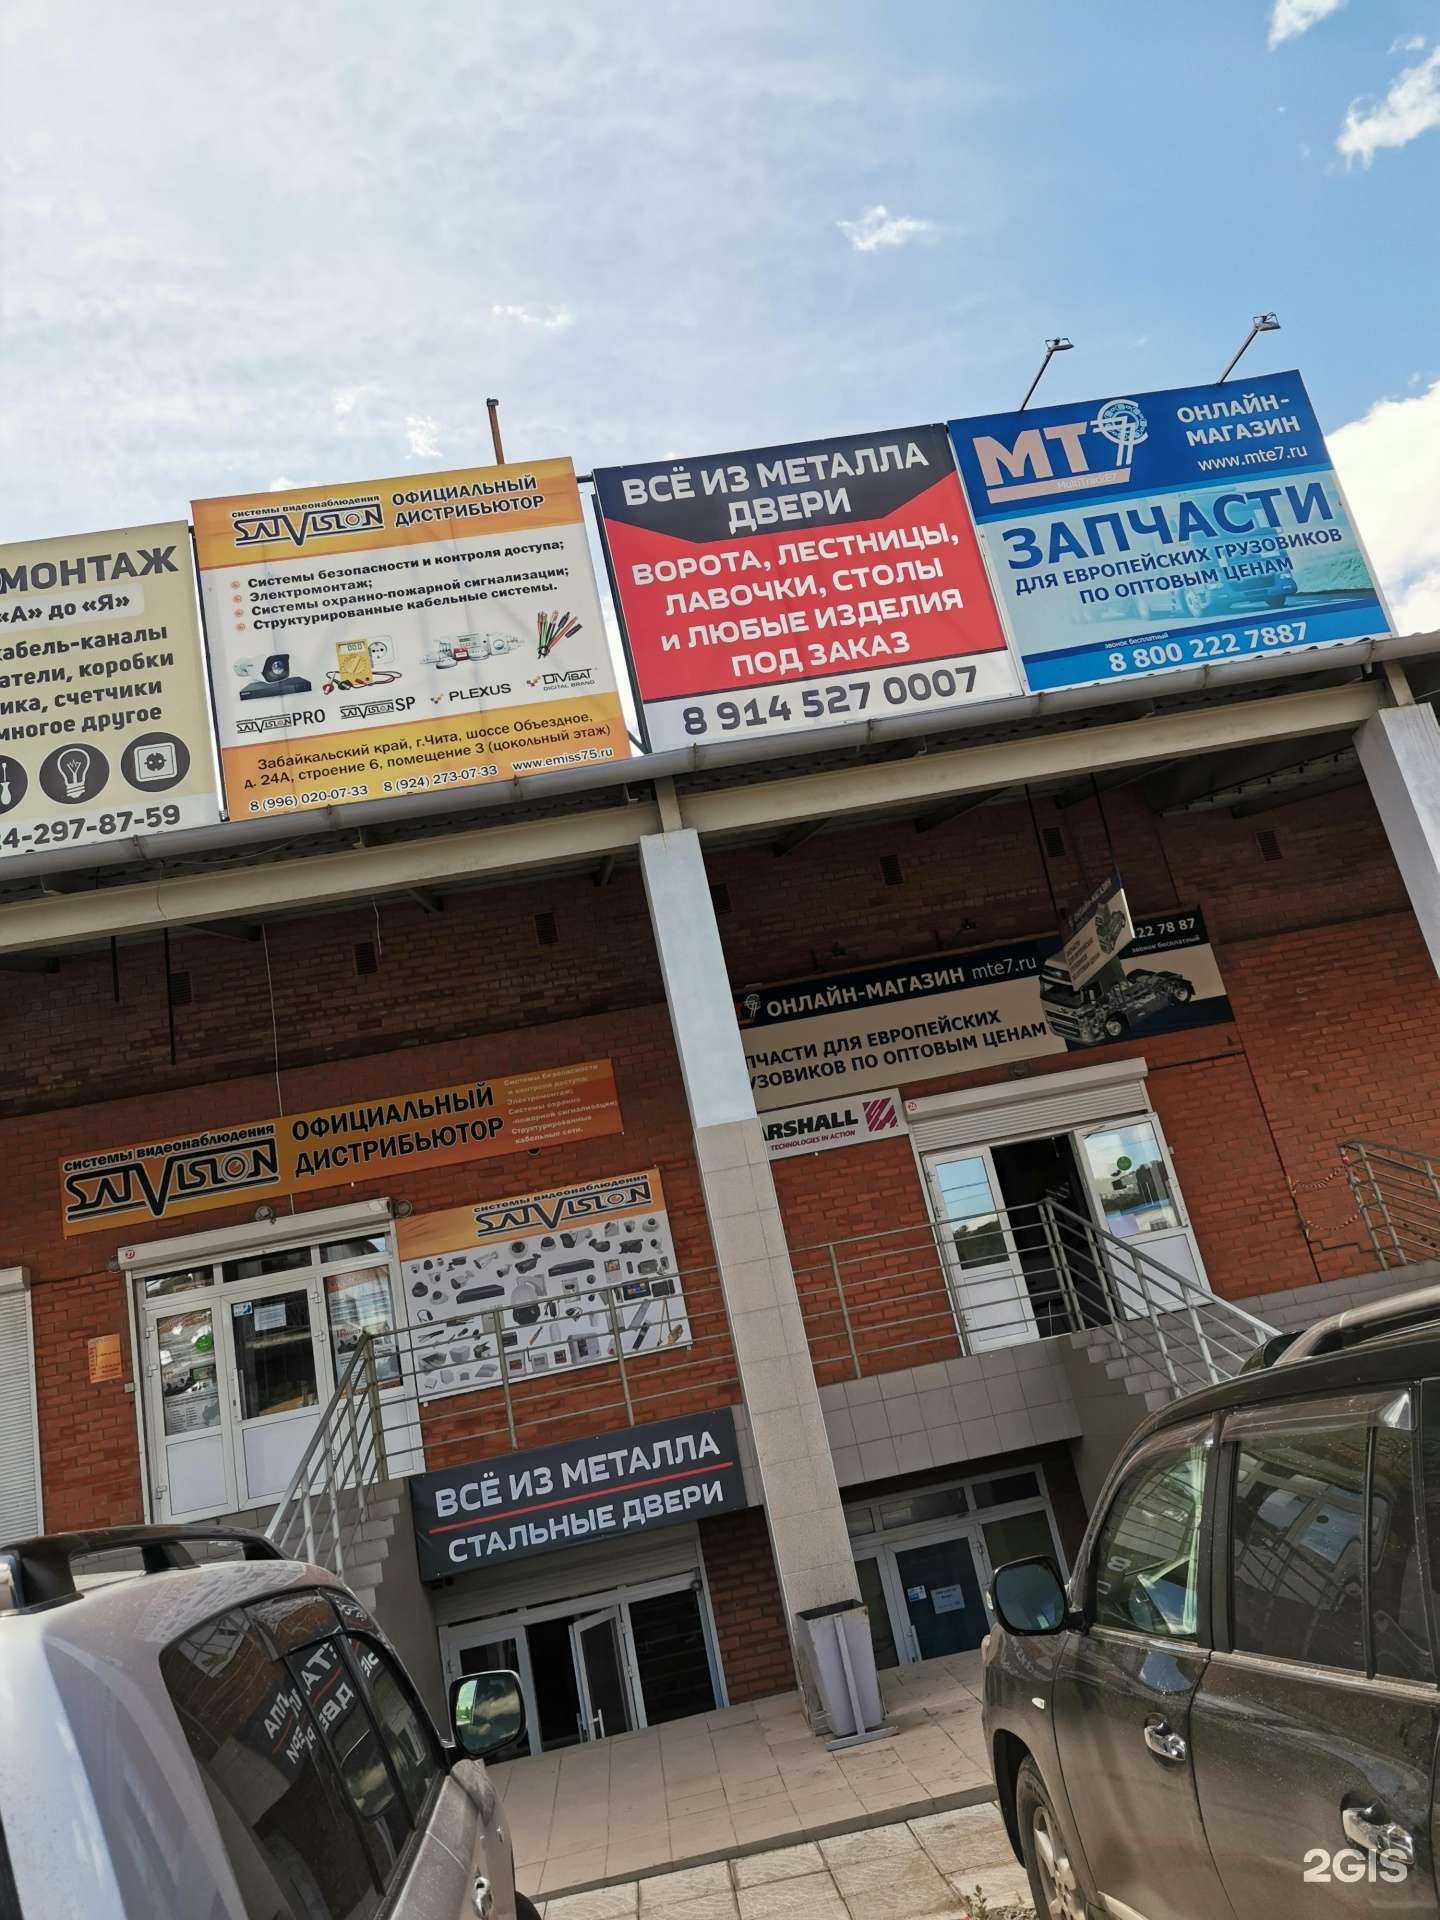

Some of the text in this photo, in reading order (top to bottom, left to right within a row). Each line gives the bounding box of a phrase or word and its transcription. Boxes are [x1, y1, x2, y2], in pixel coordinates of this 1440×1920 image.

[1177, 393, 1290, 424] ОНЛАЙН-
[1186, 415, 1301, 448] МАГАЗИН
[622, 442, 929, 506] ВСЁ ИЗ МЕТАЛЛА
[1198, 444, 1308, 472] www.mte7.ru
[231, 495, 380, 518] системы видеонаблюдения
[392, 473, 537, 506] ОФИЦИАЛЬНЫЙ
[395, 495, 545, 527] ДИСТРИБЬЮТОР
[728, 488, 852, 535] ДВЕРИ
[1002, 482, 1335, 569] ЗАПЧАСТИ
[248, 541, 565, 588] Системы безопасности и контроля доступа;
[632, 522, 959, 586] ВОРОТА, ЛЕСТНИЦЫ,
[1015, 528, 1342, 597] ДЛЯ ЕВРОПЕЙСКИХ ГРУЗОВИКОВ
[249, 579, 373, 602] Электромонтаж;
[251, 566, 570, 616] Системы охранно-пожарной сигнализации;
[665, 557, 943, 616] ЛАВОЧКИ, СТОЛЫ
[1079, 557, 1295, 605] ПО ОПТОВЫМ ЦЕНАМ
[48, 602, 77, 620] до
[82, 593, 130, 612] «Я»
[253, 582, 558, 631] Структурированные кабельные системы.
[661, 588, 964, 652] и ЛЮБЫЕ ИЗДЕЛИЯ
[0, 625, 168, 661] абель-каналы
[731, 631, 911, 676] ПОД ЗАКАЗ
[1108, 621, 1307, 672] 8 800 222 7887
[0, 651, 174, 688] атели, коробки
[448, 683, 512, 702] PLEXUS
[54, 680, 163, 708] счетчики
[683, 665, 978, 735] 8 914 527 0007
[82, 707, 162, 733] другое
[258, 744, 370, 770] Забайкальский
[374, 738, 413, 754] край,
[466, 724, 511, 740] шоссе
[514, 712, 593, 732] Объездное,
[260, 771, 294, 787] 24А,
[298, 762, 366, 782] строение
[369, 758, 383, 770] 6,
[387, 747, 472, 768] помещение
[475, 743, 485, 754] 3
[489, 730, 570, 754] (цокольный
[573, 724, 612, 740] этаж)
[383, 765, 498, 792] 8 (924) 273-07-33
[512, 748, 613, 771] www.emiss75.ru
[250, 785, 369, 812] 8 (996) 020-07-33
[0, 804, 181, 849] 4-297-87-59
[1157, 921, 1176, 934] 78
[1178, 917, 1195, 930] 87
[766, 967, 966, 1017] ОНЛАЙН-МАГАЗИН
[972, 956, 1037, 980] mte7.ru
[823, 1035, 862, 1058] ДЛЯ
[867, 1009, 1001, 1048] ЕВРОПЕЙСКИХ
[851, 1054, 879, 1072] ПО
[884, 1035, 978, 1067] ОПТОВЫМ
[984, 1021, 1048, 1048] ЦЕНАМ
[291, 1081, 495, 1142] ОФИЦИАЛЬНЫЙ
[63, 1124, 274, 1171] системы видеонаблюдения
[295, 1117, 505, 1178] ДИСТРИБЬЮТОР
[770, 1129, 856, 1151] TECHNOLOGIES IN ACTION
[473, 1174, 648, 1213] системы видеонаблюдения
[435, 1431, 721, 1518] ВСЁ ИЗ МЕТАЛЛА
[448, 1480, 724, 1563] СТАЛЬНЫЕ ДВЕРИ
